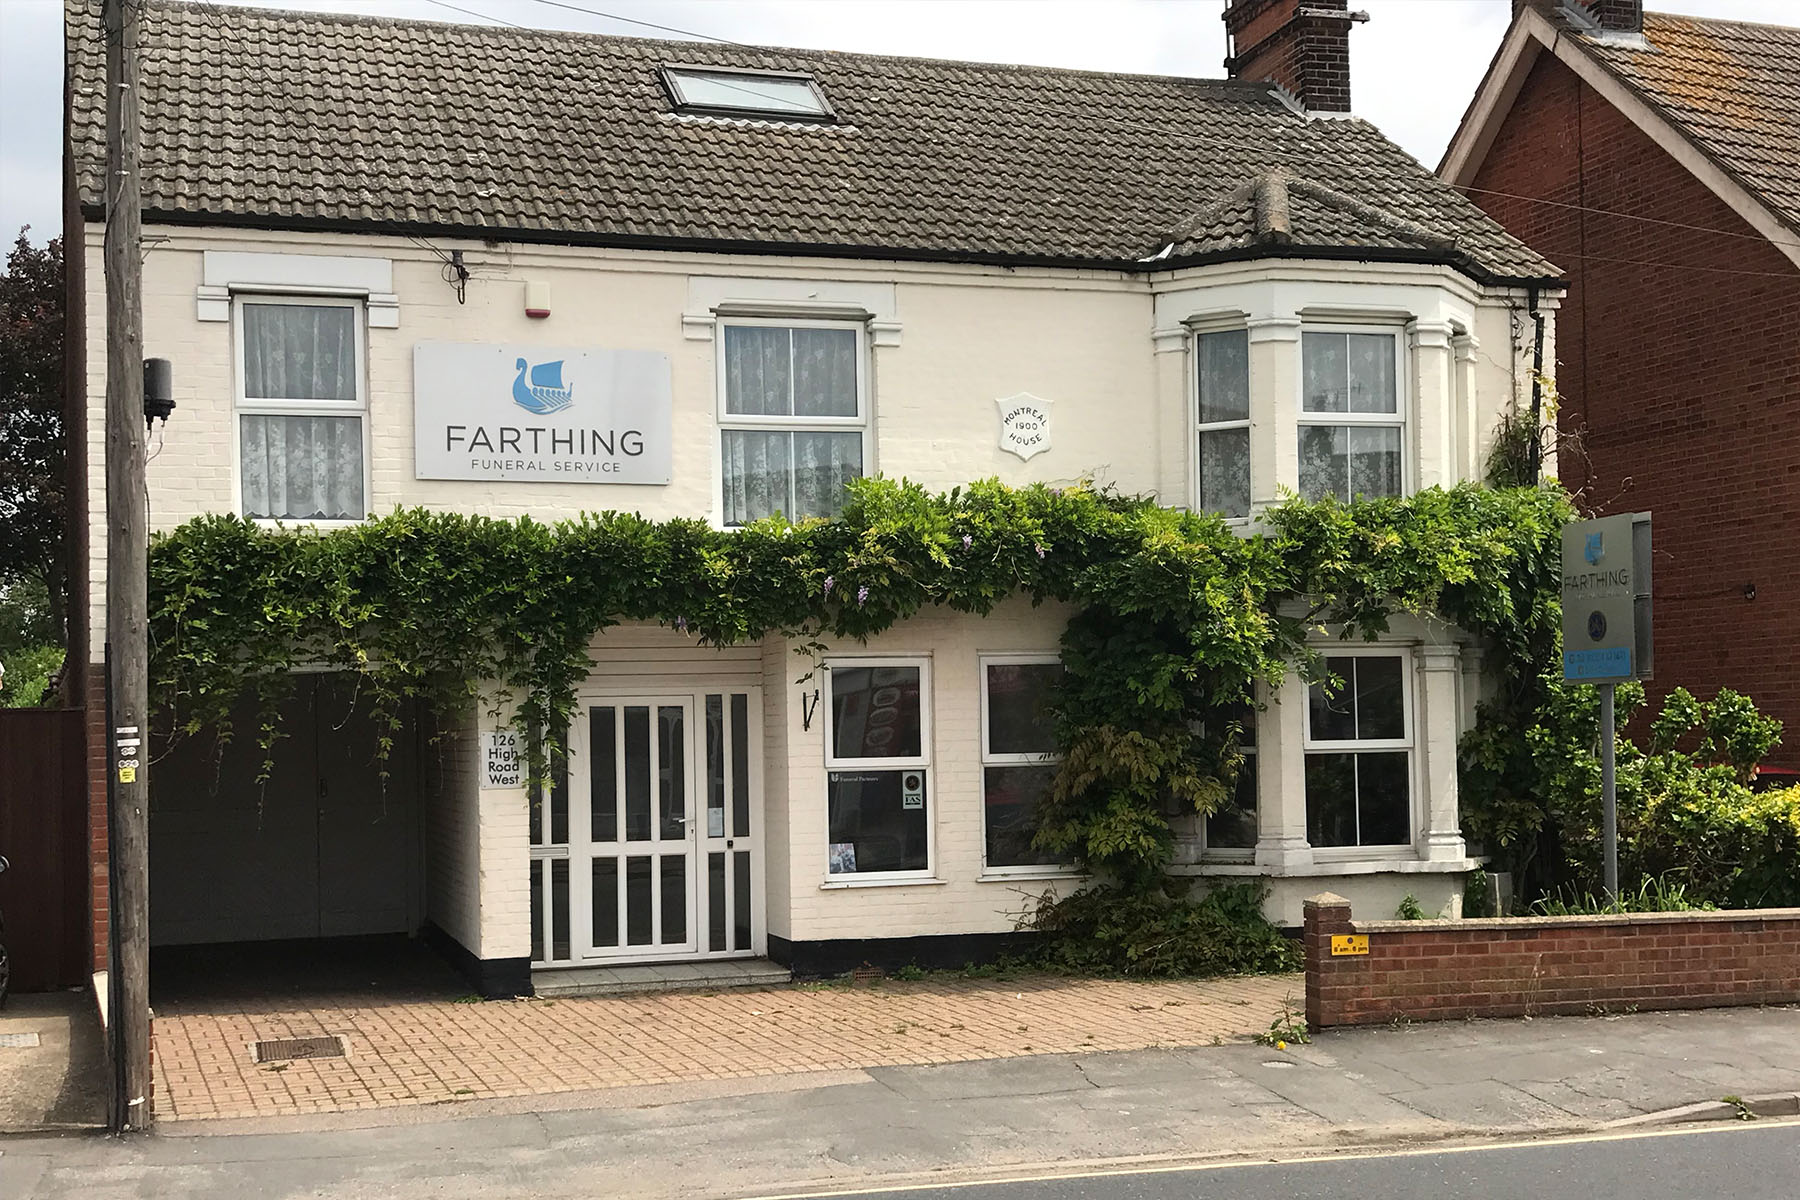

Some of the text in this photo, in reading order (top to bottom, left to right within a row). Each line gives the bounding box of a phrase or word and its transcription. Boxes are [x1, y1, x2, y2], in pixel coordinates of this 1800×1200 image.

[1004, 407, 1047, 426] MONTREAL
[1015, 422, 1038, 430] 1900
[446, 425, 644, 456] FARTHING
[1009, 432, 1042, 446] HOUSE
[471, 459, 621, 473] FUNERAL SERVICE
[1564, 568, 1629, 592] FARTHING
[492, 734, 516, 746] 126
[488, 747, 518, 761] High
[488, 760, 520, 773] Road
[488, 773, 520, 785] West
